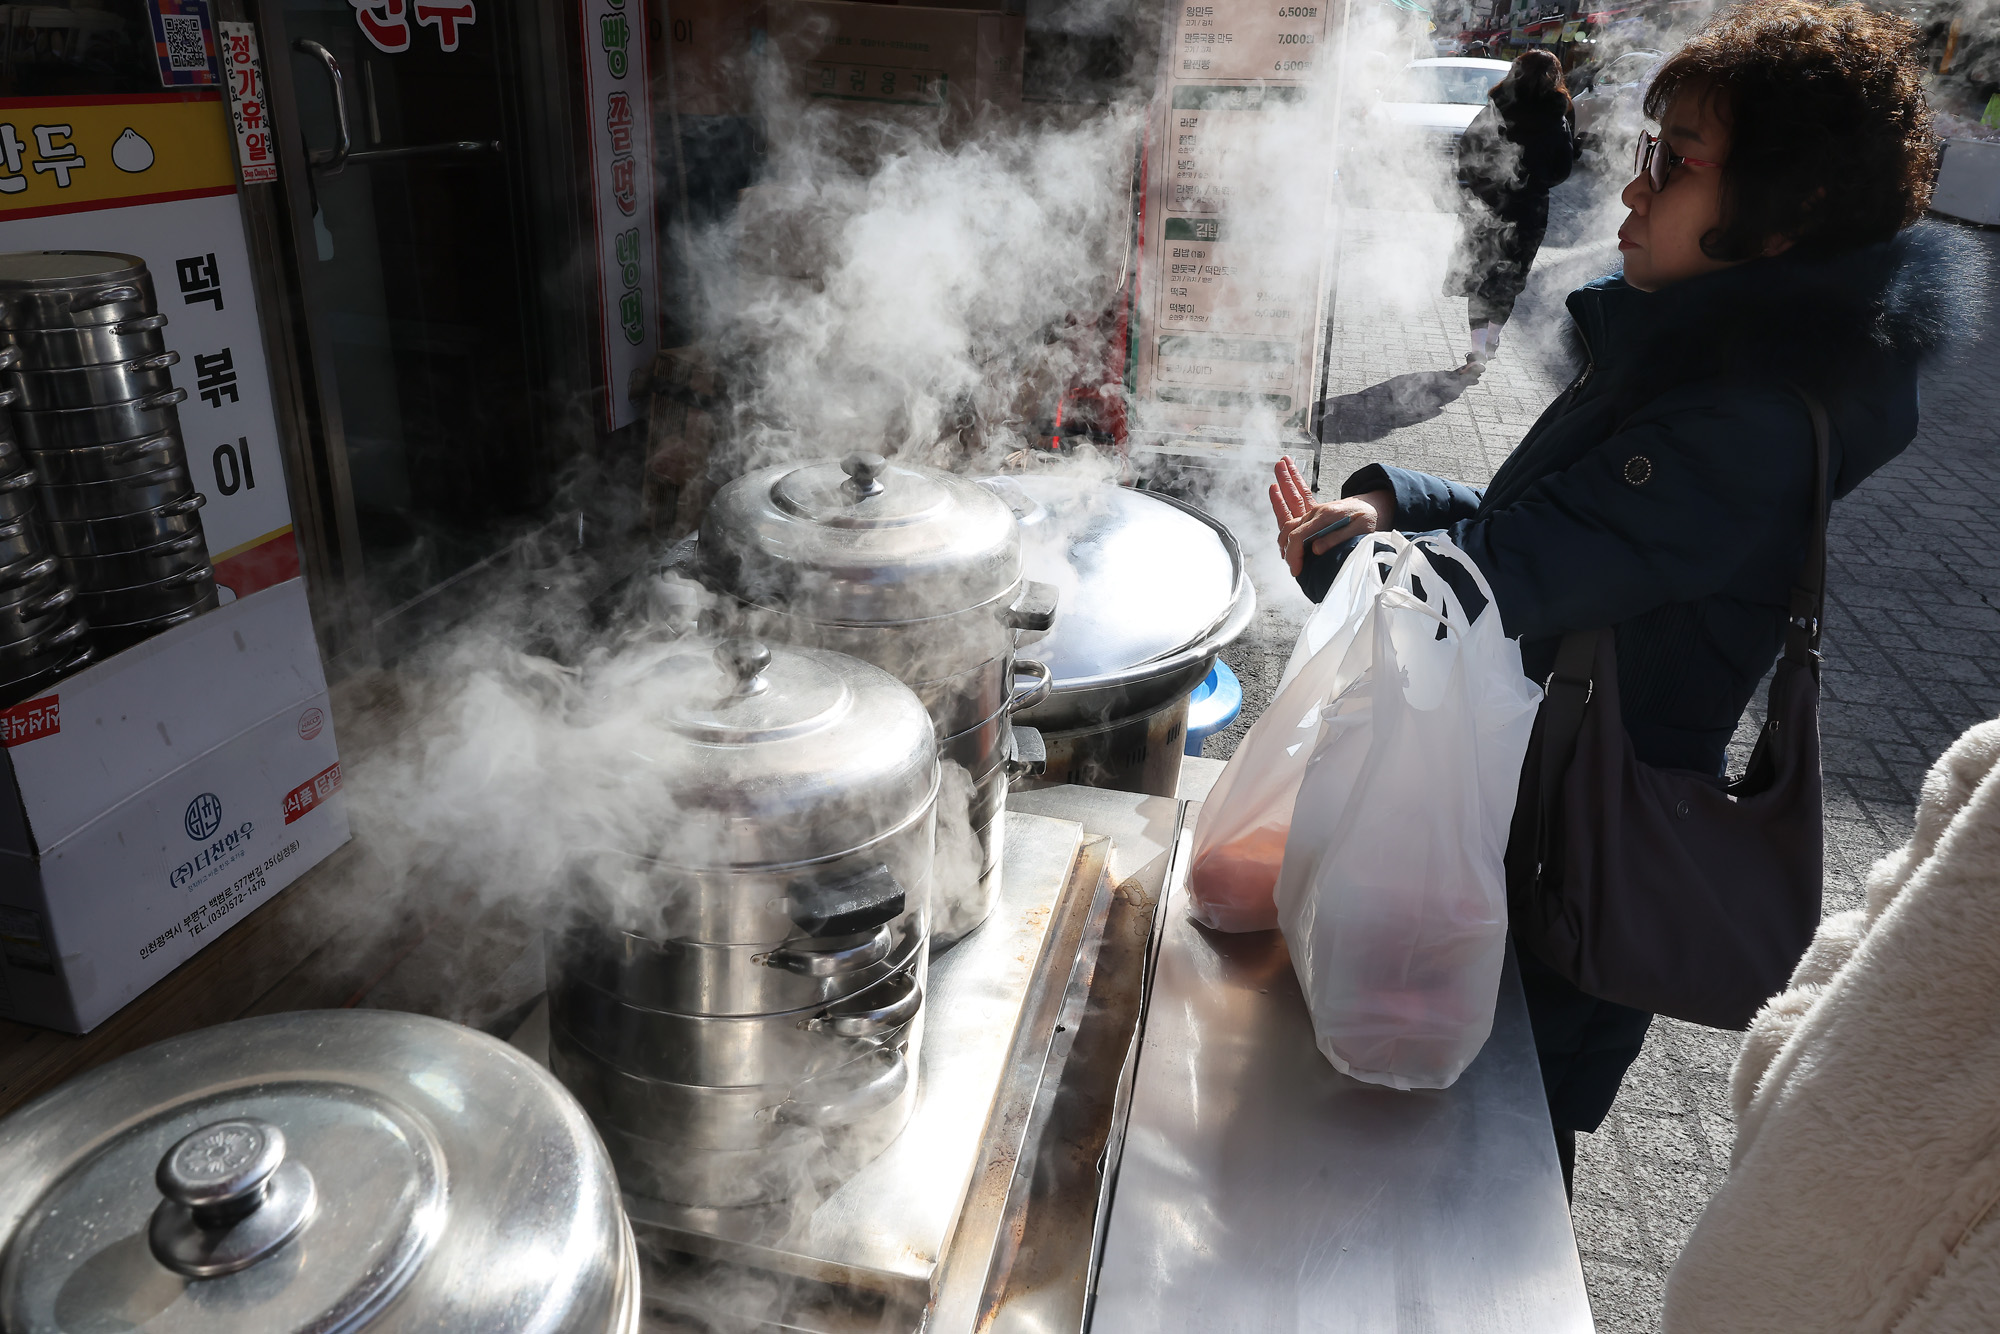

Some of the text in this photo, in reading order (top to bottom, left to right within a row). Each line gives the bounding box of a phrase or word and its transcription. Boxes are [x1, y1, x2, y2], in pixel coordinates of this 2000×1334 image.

[1186, 6, 1317, 18] 왕만두 6,500원
[1184, 33, 1314, 45] 만둣국용 만두 7,000원
[230, 35, 267, 161] 정기휴일
[1180, 117, 1198, 128] 라면
[600, 0, 630, 79] 빵
[615, 226, 645, 347] 냉면
[1172, 247, 1206, 259] 김밥 (1줄)
[1171, 264, 1196, 274] 만둣국
[1170, 287, 1188, 297] 떡국
[1169, 303, 1195, 314] 떡볶이
[139, 923, 183, 960] 인천광역시
[183, 904, 208, 928] 부평구
[208, 887, 234, 907] 백범로
[233, 866, 264, 893] 577번길
